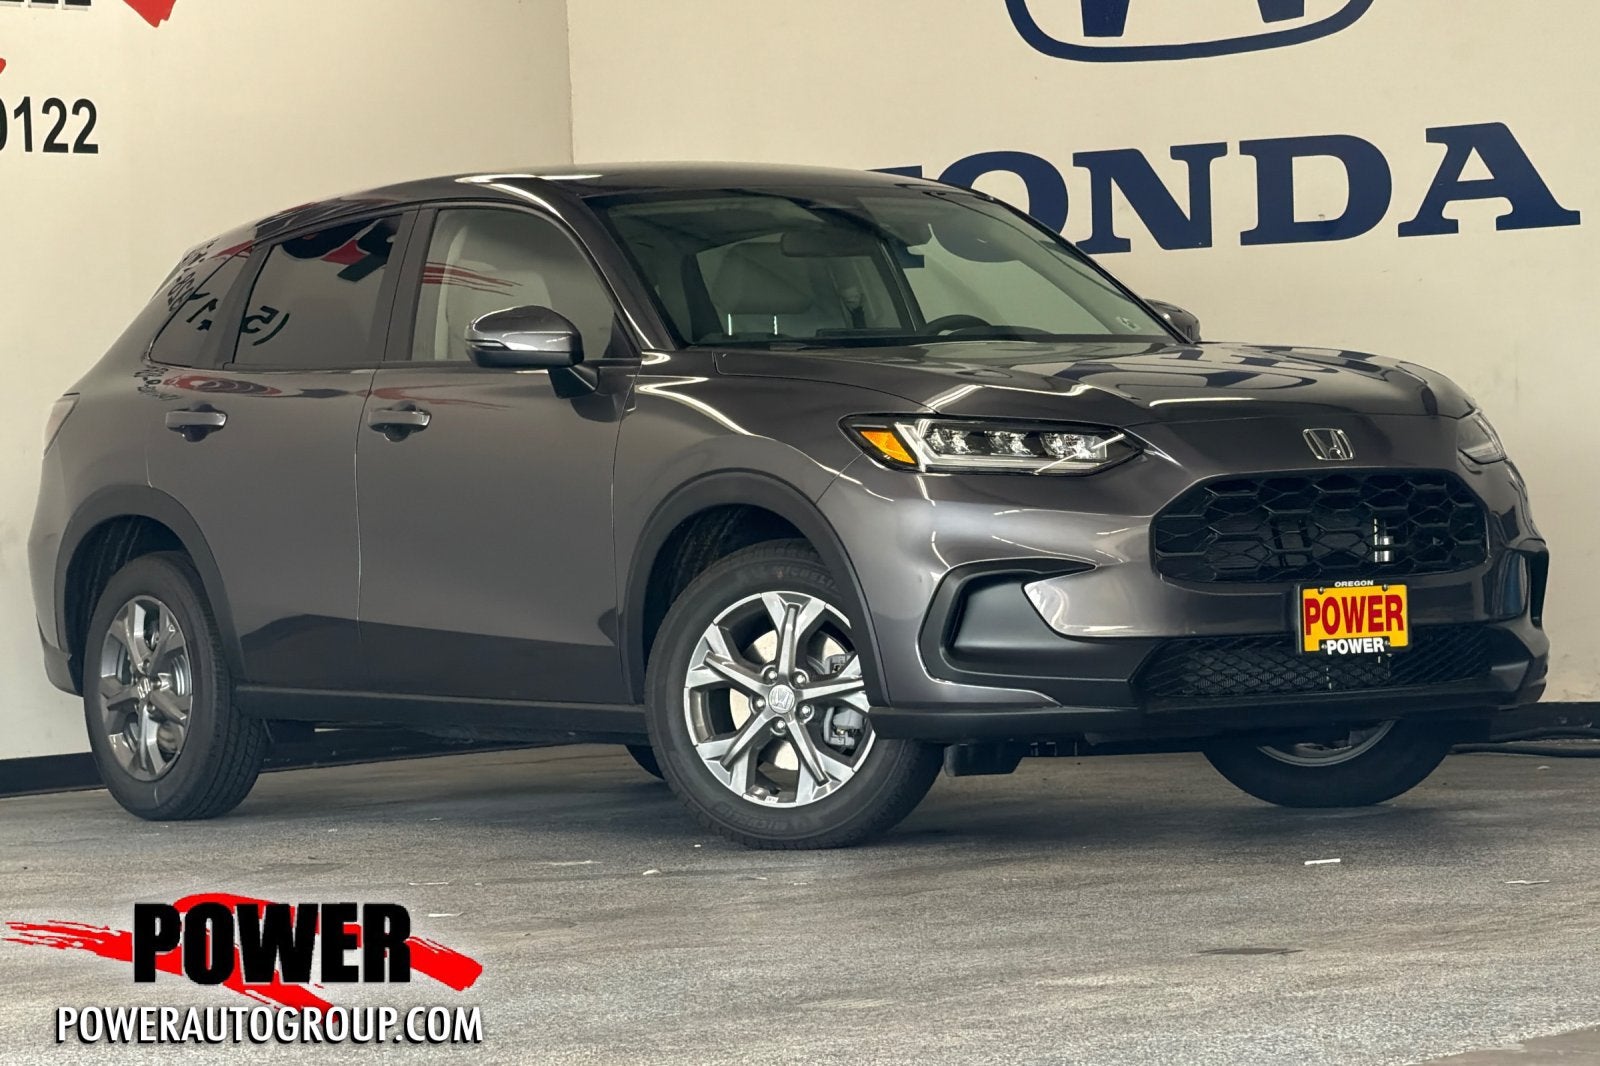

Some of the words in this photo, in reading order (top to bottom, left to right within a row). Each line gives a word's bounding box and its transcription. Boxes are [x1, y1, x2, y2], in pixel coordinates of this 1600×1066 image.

[0, 96, 99, 154] 122
[1334, 579, 1374, 588] OREGON
[1304, 594, 1404, 636] POWER
[1326, 637, 1385, 656] POWER
